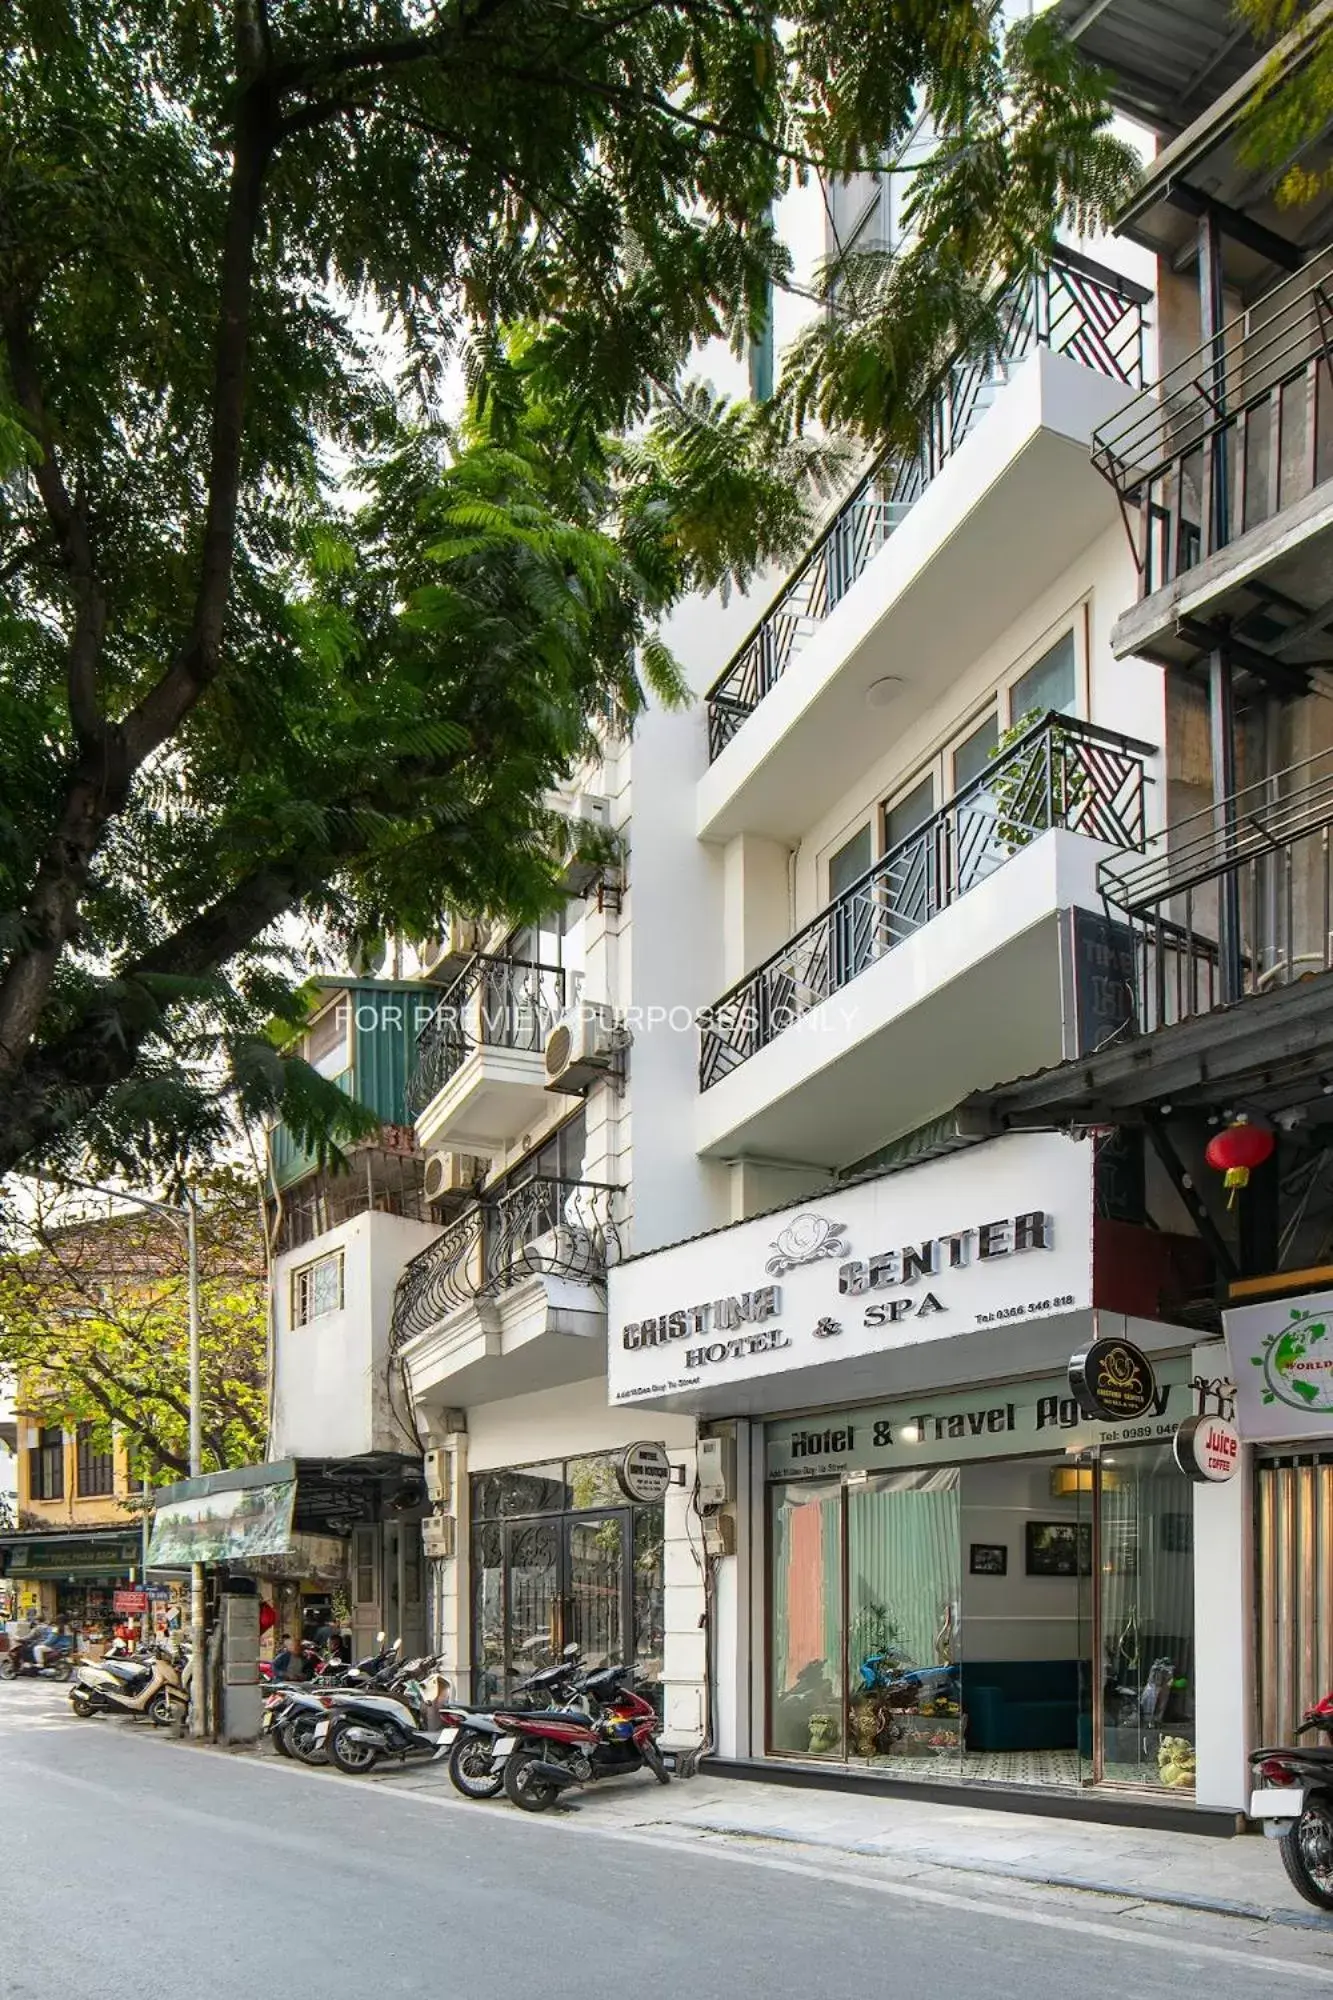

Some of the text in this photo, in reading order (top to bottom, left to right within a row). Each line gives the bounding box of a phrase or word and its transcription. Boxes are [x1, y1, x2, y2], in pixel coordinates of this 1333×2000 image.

[622, 1210, 1056, 1352] CRISTINA CENTER
[684, 1292, 948, 1369] HOTEL & SPA
[791, 1425, 855, 1458] Hotel
[872, 1419, 894, 1448] &
[909, 1402, 1016, 1443] Travel
[1100, 1431, 1120, 1442] Tel:
[1205, 1426, 1238, 1458] Juice
[1208, 1457, 1231, 1472] COFFEE
